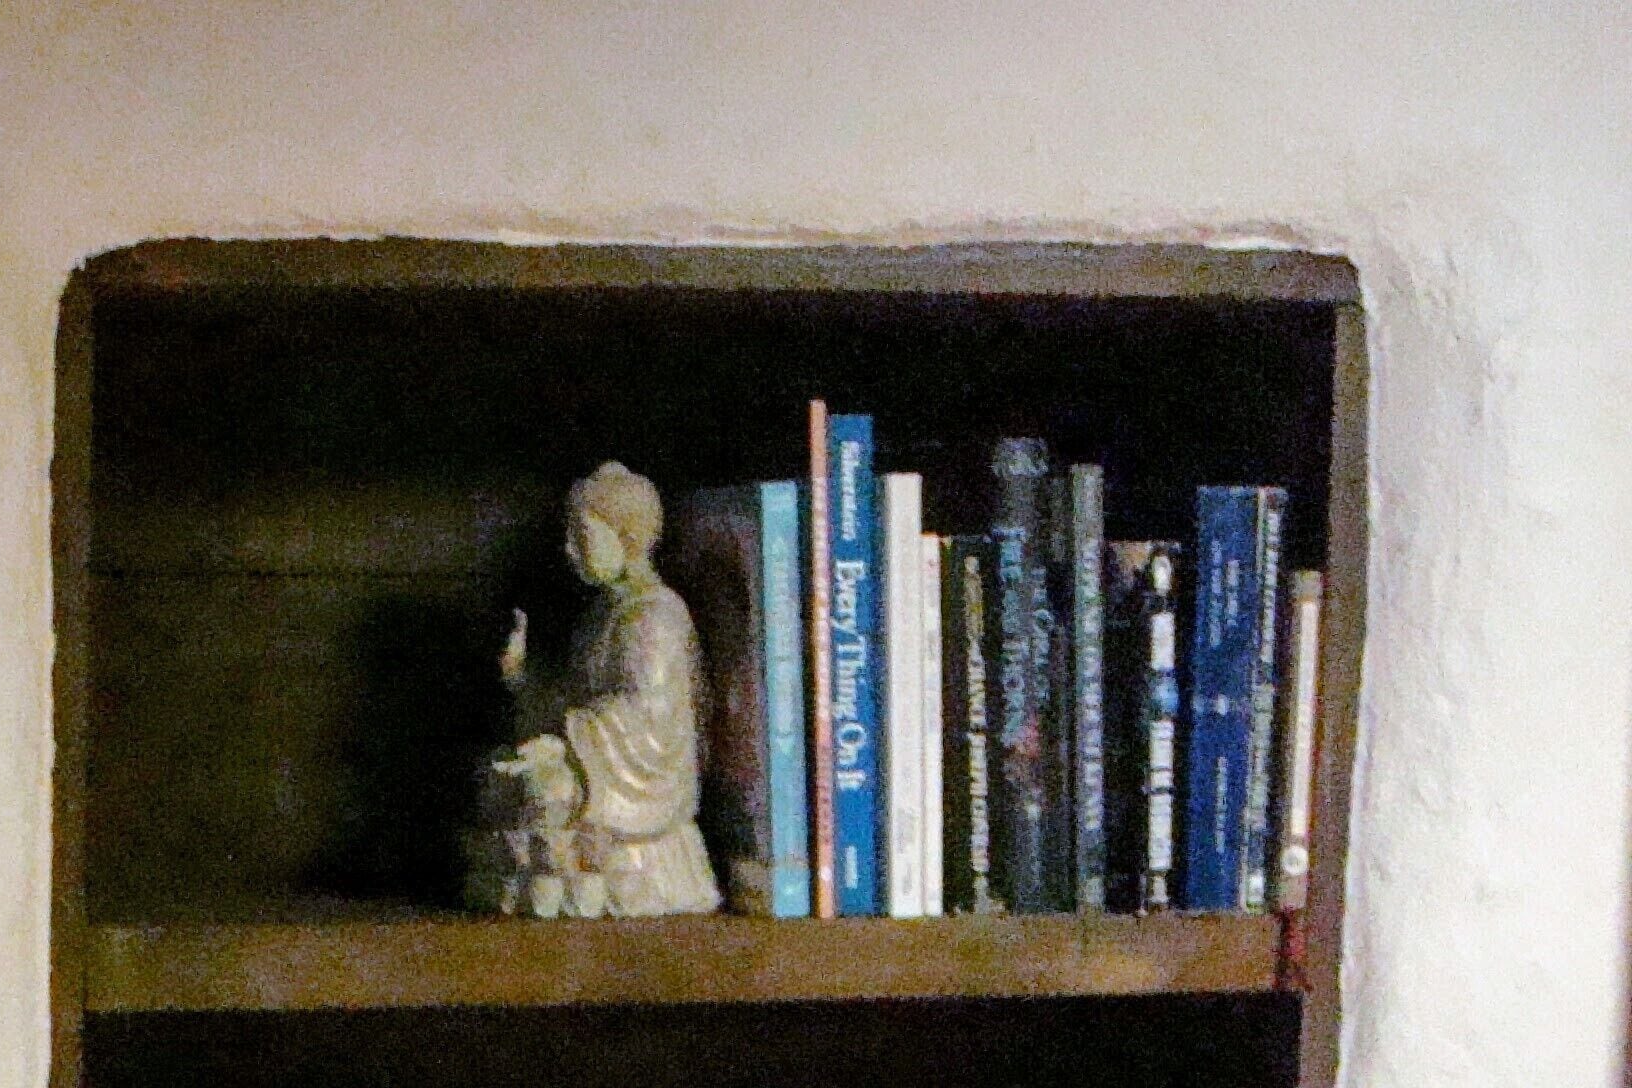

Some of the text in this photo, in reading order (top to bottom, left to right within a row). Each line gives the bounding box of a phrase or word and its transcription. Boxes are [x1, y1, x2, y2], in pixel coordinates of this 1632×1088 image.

[833, 559, 865, 792] Every Thing On It
